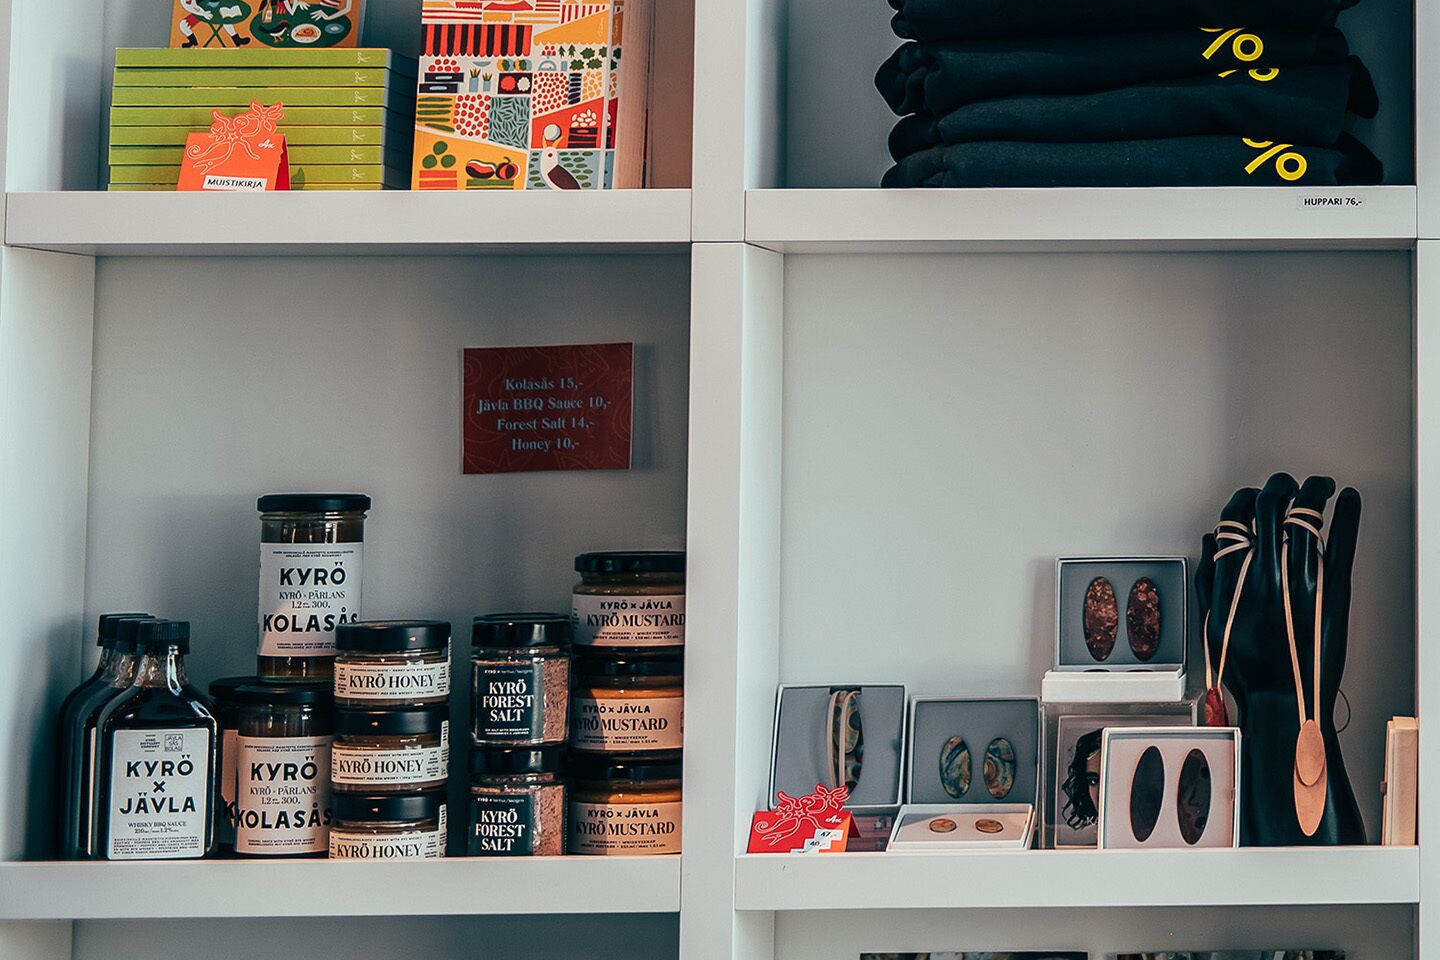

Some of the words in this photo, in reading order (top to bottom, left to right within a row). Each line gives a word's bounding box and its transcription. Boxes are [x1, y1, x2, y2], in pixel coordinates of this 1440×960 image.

[207, 178, 263, 189] MUISTIKIRJA
[1304, 197, 1342, 206] HUPPARI
[505, 377, 555, 390] Kolasås
[476, 398, 509, 414] Jävla
[513, 398, 544, 411] BBQ
[548, 397, 583, 409] Sauce
[497, 418, 537, 431] Forest
[541, 417, 565, 430] Salt
[512, 437, 550, 452] Honey
[280, 562, 346, 586] KYRÖ
[308, 590, 346, 600] PÄRLANS
[601, 600, 628, 610] KYRÖ
[639, 599, 673, 610] JÄVLA
[263, 607, 358, 633] KOLASÅS
[587, 612, 620, 627] KYRÖ
[622, 613, 686, 627] MUSTARD
[349, 673, 385, 688] KYRÖ
[389, 674, 435, 689] HONEY
[489, 678, 527, 694] KYRÖ
[483, 694, 534, 708] FOREST
[617, 703, 650, 714] JÄVLA
[490, 709, 524, 722] SALT
[575, 716, 599, 731] YRÖ
[601, 717, 668, 732] MUSTARD
[126, 755, 194, 777] KYRÖ
[251, 756, 318, 781] KYRÖ
[340, 758, 371, 773] KYRÖ
[374, 759, 424, 773] HONEY
[119, 792, 196, 814] JÄVLA
[237, 802, 333, 828] KOLASÅS
[481, 808, 518, 823] KYRÖ
[588, 807, 613, 818] KYRÖ
[625, 807, 659, 818] JÄVLA
[475, 823, 525, 837] FOREST
[576, 820, 606, 836] KYRÖ
[608, 821, 675, 836] MUSTARD
[337, 843, 370, 858] KYRÖ
[373, 843, 422, 858] HONEY
[481, 838, 515, 851] SALT
